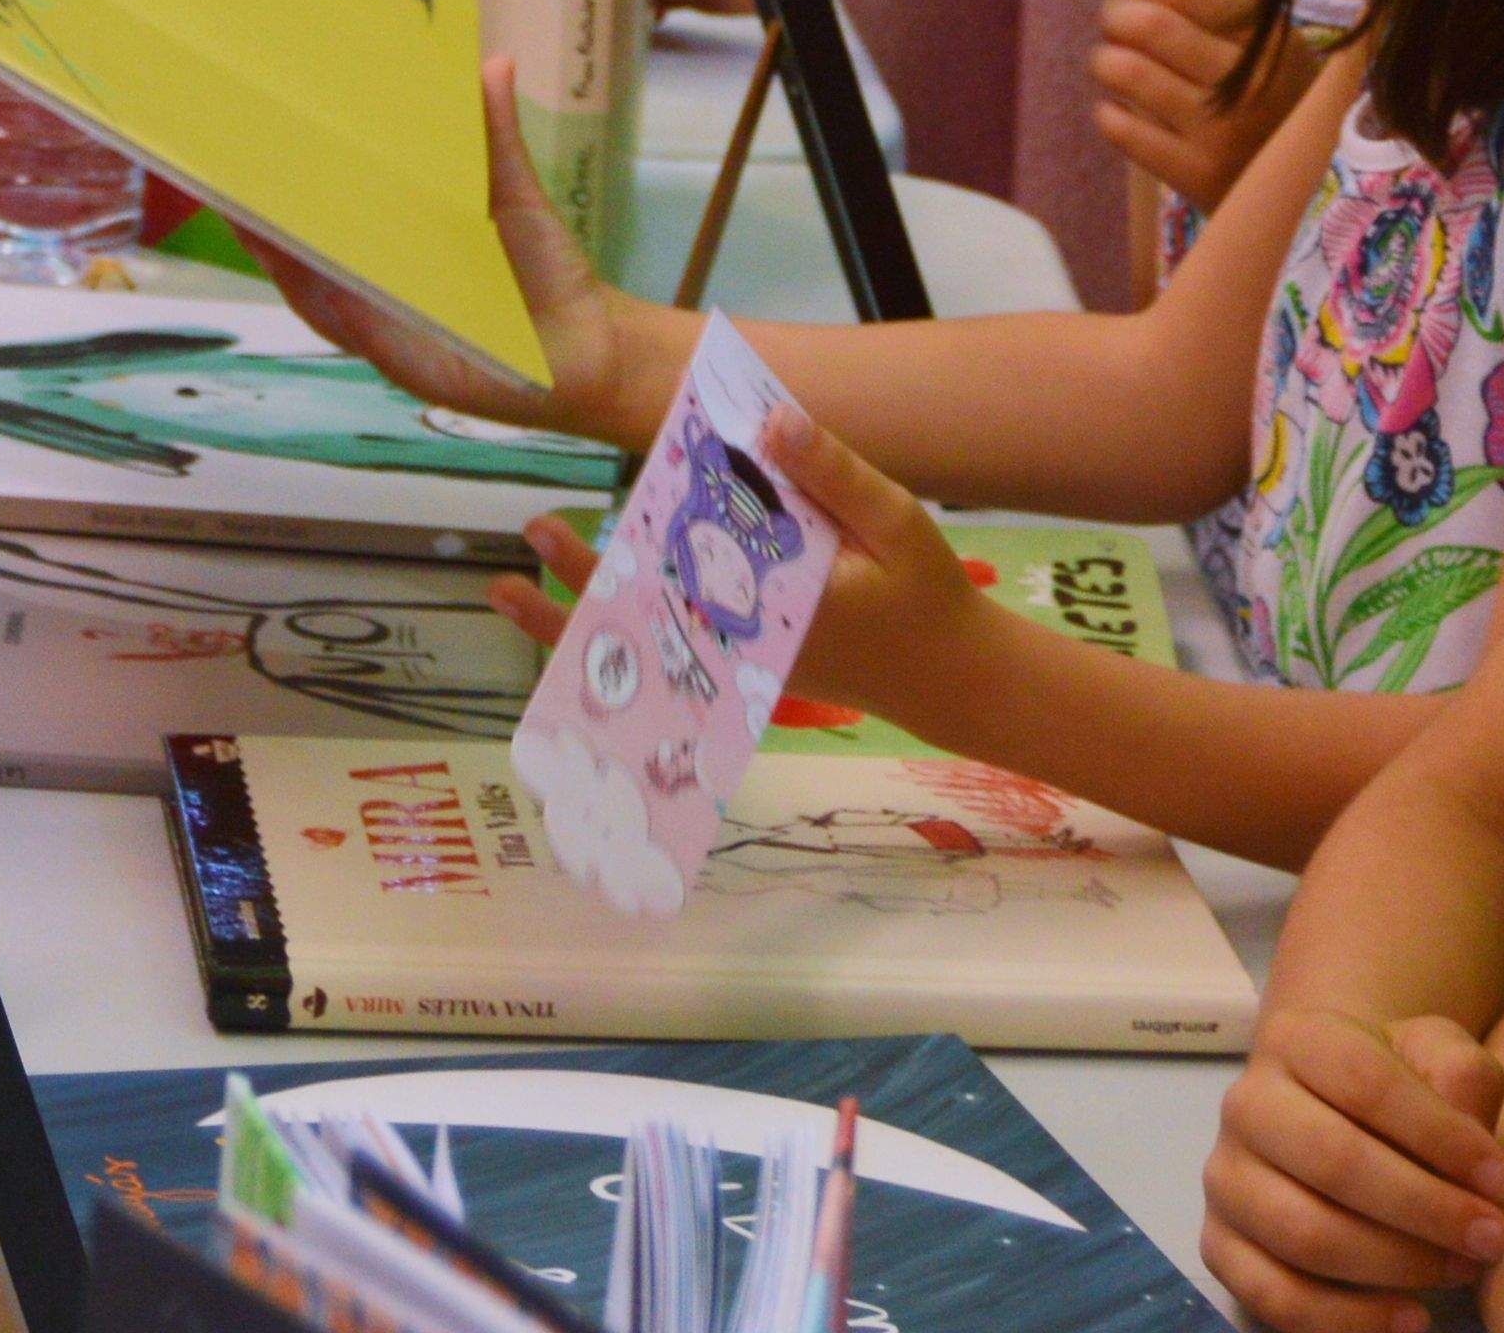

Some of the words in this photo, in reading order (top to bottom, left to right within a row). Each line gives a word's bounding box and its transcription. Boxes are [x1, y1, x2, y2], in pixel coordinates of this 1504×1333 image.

[348, 760, 491, 897] MIRA
[344, 996, 405, 1015] MIRA
[504, 999, 557, 1019] TINA
